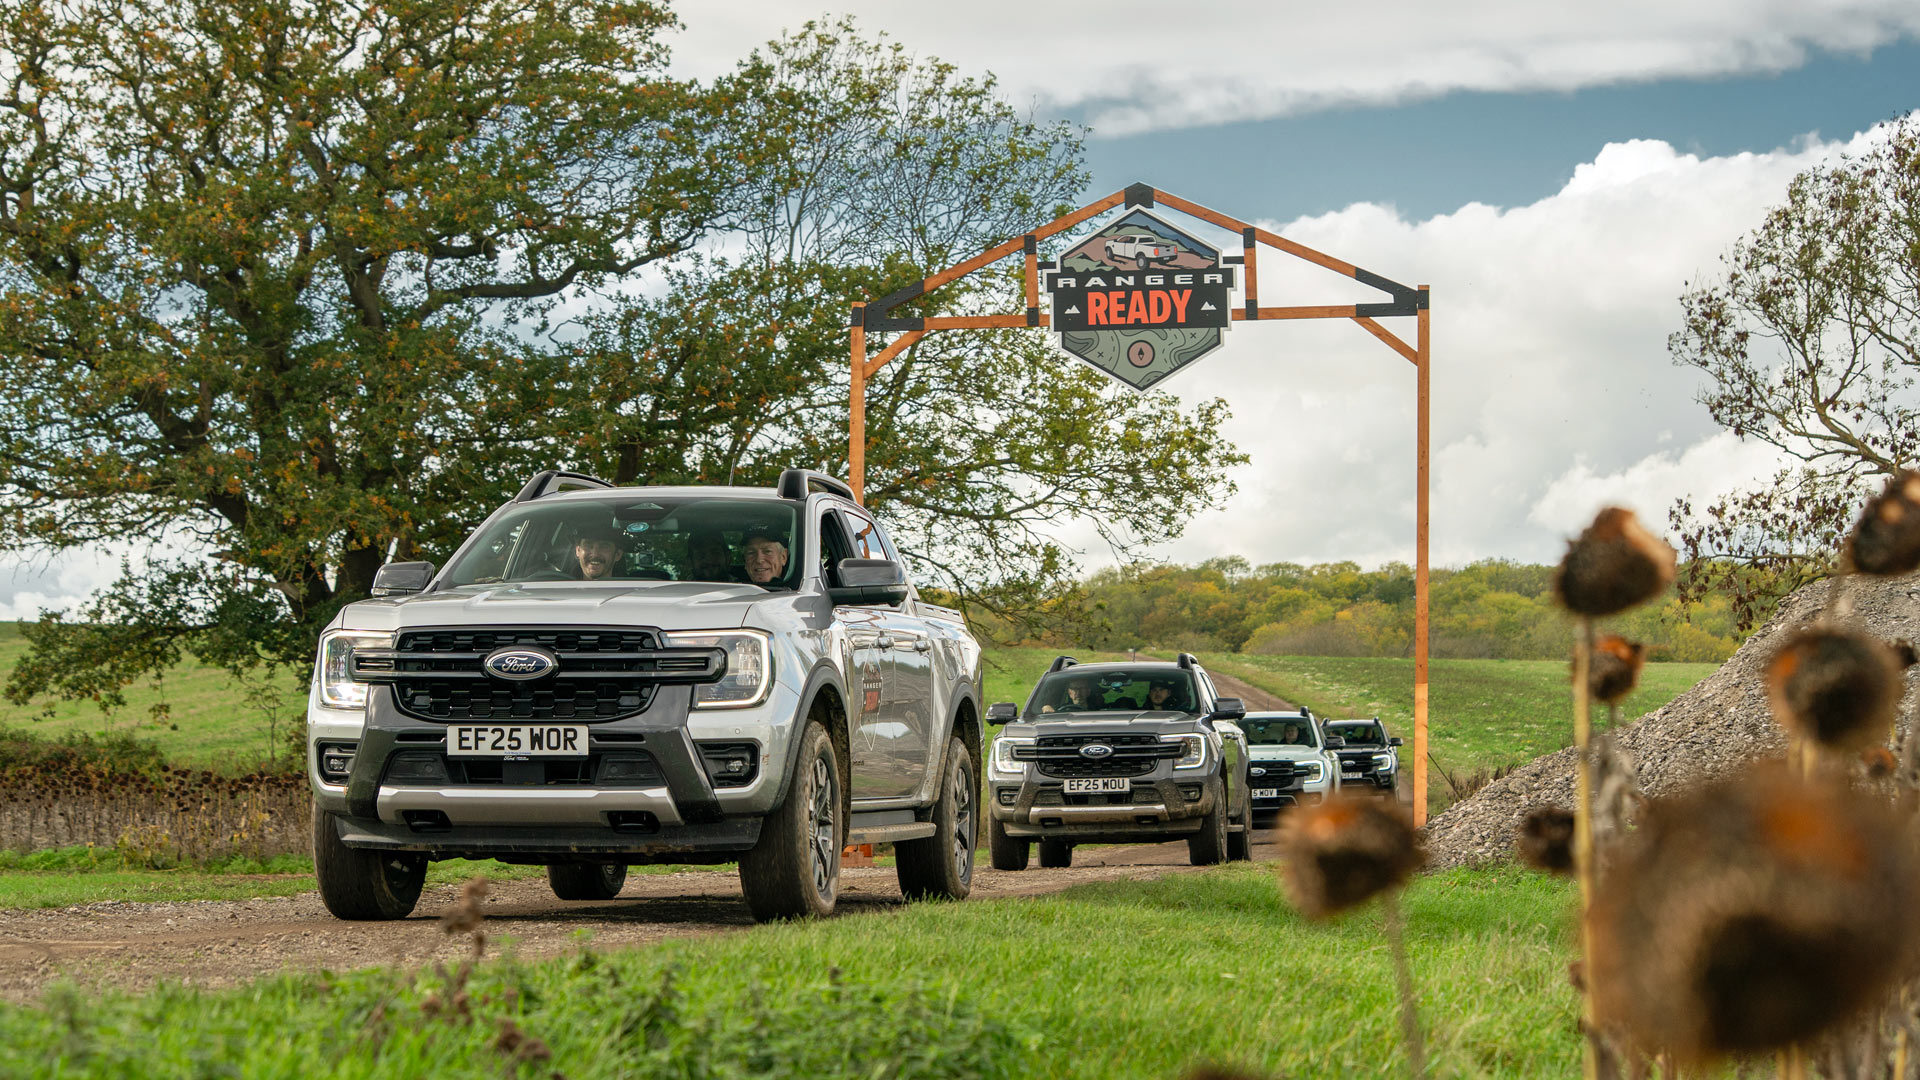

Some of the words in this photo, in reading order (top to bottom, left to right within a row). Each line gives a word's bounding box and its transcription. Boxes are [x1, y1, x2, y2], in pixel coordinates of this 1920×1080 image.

[1057, 274, 1223, 288] RANGER
[1088, 289, 1193, 326] READY
[502, 656, 537, 672] Ford
[458, 728, 521, 751] EF25
[530, 728, 578, 751] WOR
[1069, 780, 1099, 791] EF25
[1102, 779, 1125, 790] WOU
